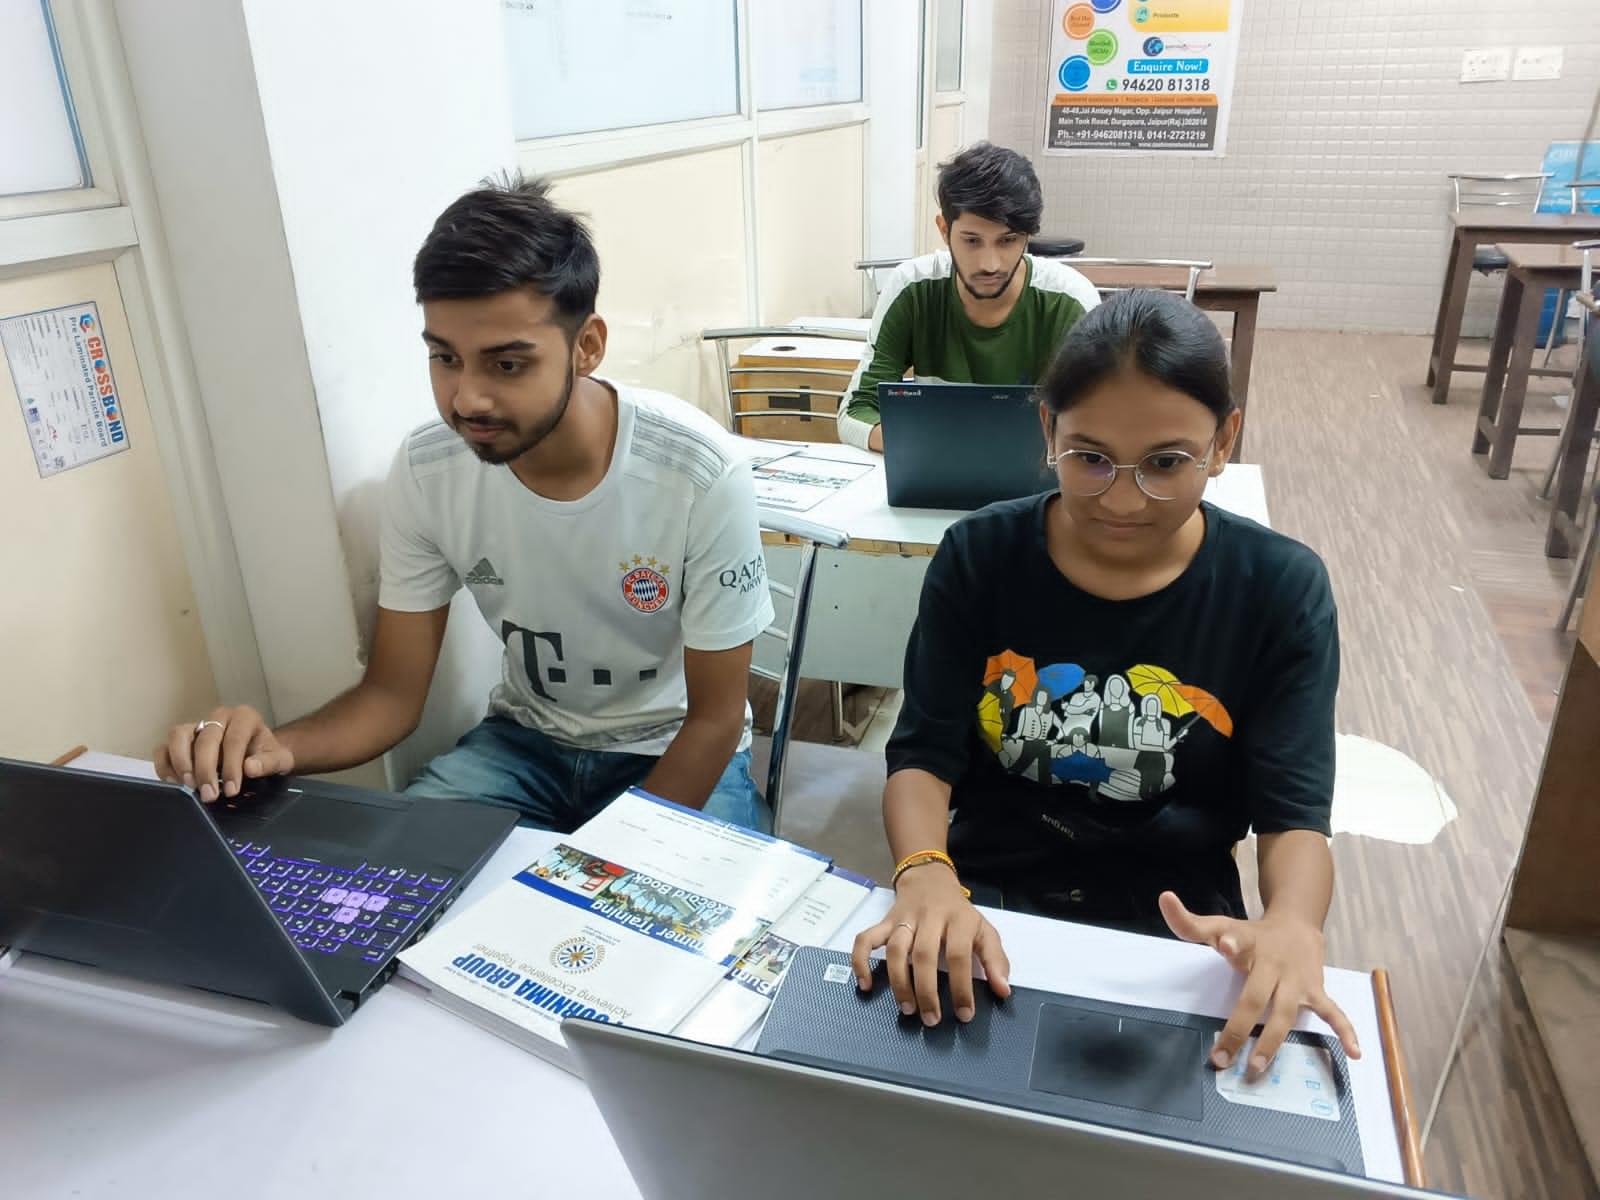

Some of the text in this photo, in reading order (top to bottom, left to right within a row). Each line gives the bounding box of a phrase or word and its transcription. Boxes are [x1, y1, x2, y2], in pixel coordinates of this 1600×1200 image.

[1133, 61, 1203, 74] Enquire Now!
[1122, 79, 1210, 91] 94620 81318
[73, 335, 91, 384] Laminated
[87, 384, 101, 419] Particle
[95, 420, 108, 448] Board
[87, 336, 124, 444] CROSSBOND
[631, 872, 673, 898] Book
[672, 886, 729, 915] Record
[588, 899, 656, 934] Training
[472, 943, 518, 969] Together
[451, 953, 521, 990] GROUP
[518, 964, 577, 994] Excellence
[577, 988, 632, 1020] Achieving
